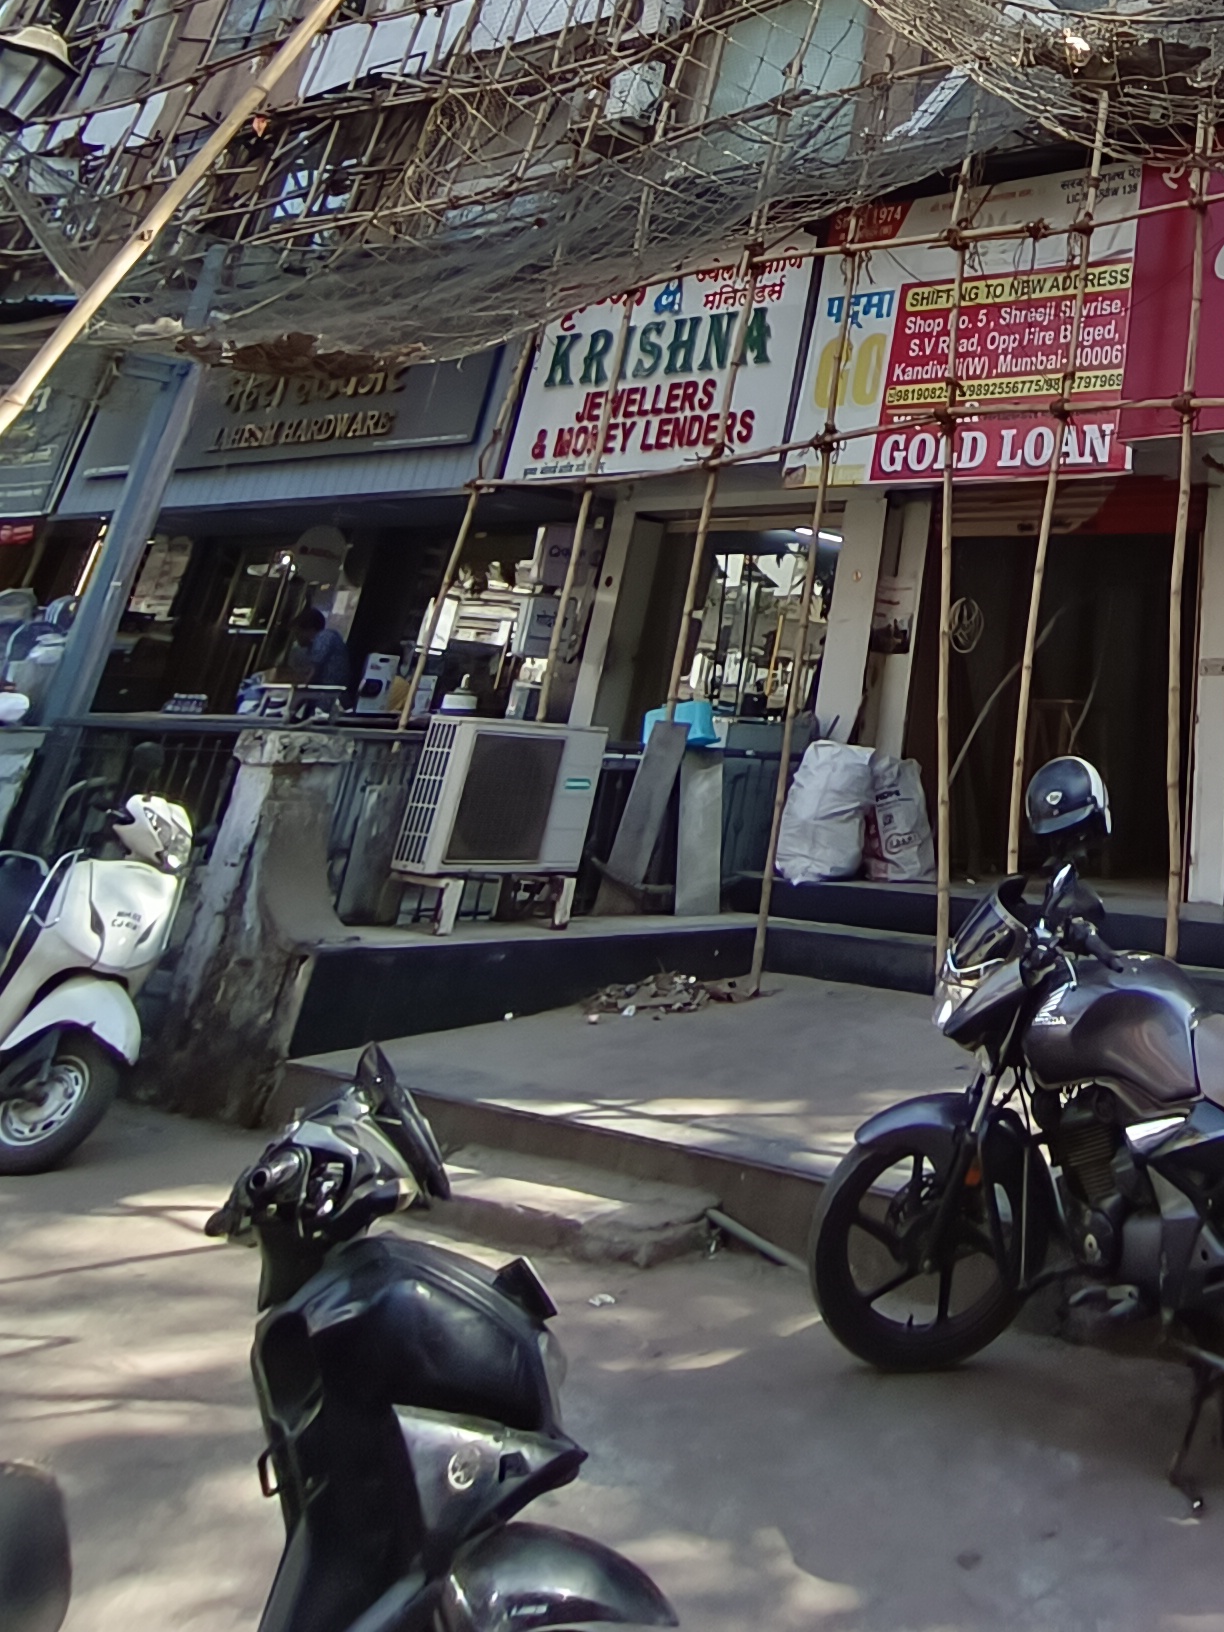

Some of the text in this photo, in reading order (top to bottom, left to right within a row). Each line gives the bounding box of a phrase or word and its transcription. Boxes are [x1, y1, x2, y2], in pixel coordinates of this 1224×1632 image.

[873, 206, 901, 224] 1974
[910, 286, 979, 307] SHIFTNG
[985, 283, 1004, 299] TO
[1009, 277, 1046, 297] NEW
[905, 316, 943, 336] Shop
[909, 337, 935, 356] S.V
[937, 333, 980, 355] Rad,
[987, 331, 1019, 352] Opp
[1060, 320, 1118, 346] Biged,
[544, 307, 771, 387] KRISHNA
[576, 378, 716, 423] JEWELLERS
[279, 410, 393, 445] HARDWARE
[640, 410, 755, 452] LENDERS
[880, 423, 1114, 473] GOLD LOAN
